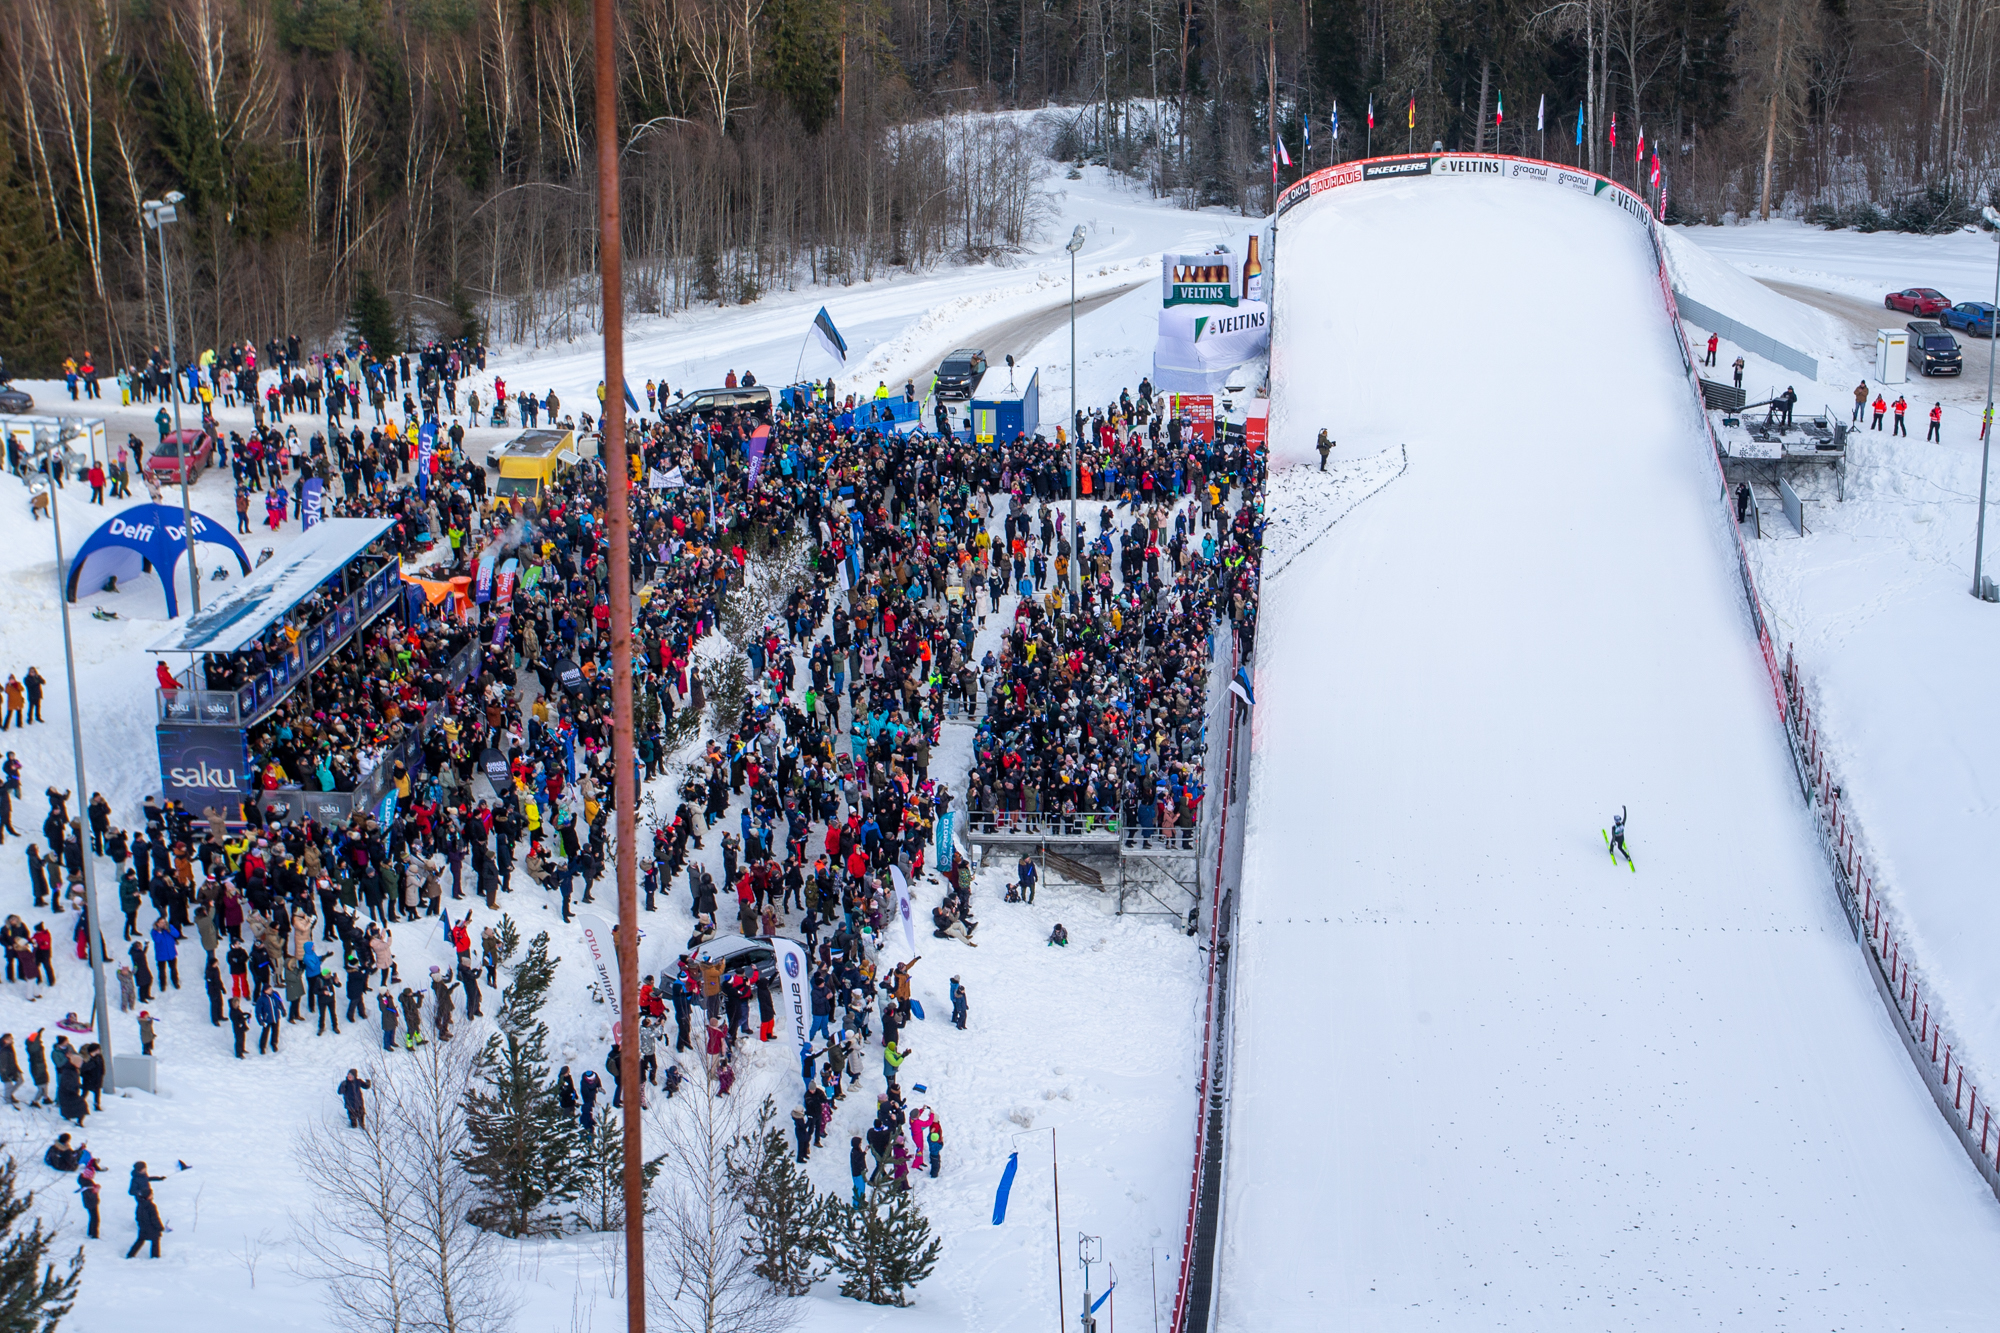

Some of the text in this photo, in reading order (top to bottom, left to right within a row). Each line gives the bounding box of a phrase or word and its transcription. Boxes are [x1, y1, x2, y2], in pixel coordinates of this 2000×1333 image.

[1367, 162, 1428, 176] SKECHERS
[1450, 160, 1499, 173] VELTINS
[1512, 164, 1548, 177] graanul
[1311, 171, 1362, 194] BAUHAUS
[1558, 172, 1589, 185] graanul
[1291, 183, 1309, 199] OKAL
[1573, 183, 1588, 191] invest
[1618, 191, 1649, 226] VELTINS
[1180, 287, 1224, 299] VELTINS
[1219, 312, 1265, 334] VELTINS
[1139, 432, 1169, 440] VENS
[419, 433, 433, 476] saku
[303, 490, 321, 527] aku
[109, 518, 155, 542] Delfi
[164, 515, 207, 541] Defi
[168, 703, 191, 713] saku
[207, 703, 229, 714] saku
[170, 761, 238, 788] saku
[319, 803, 341, 814] saku
